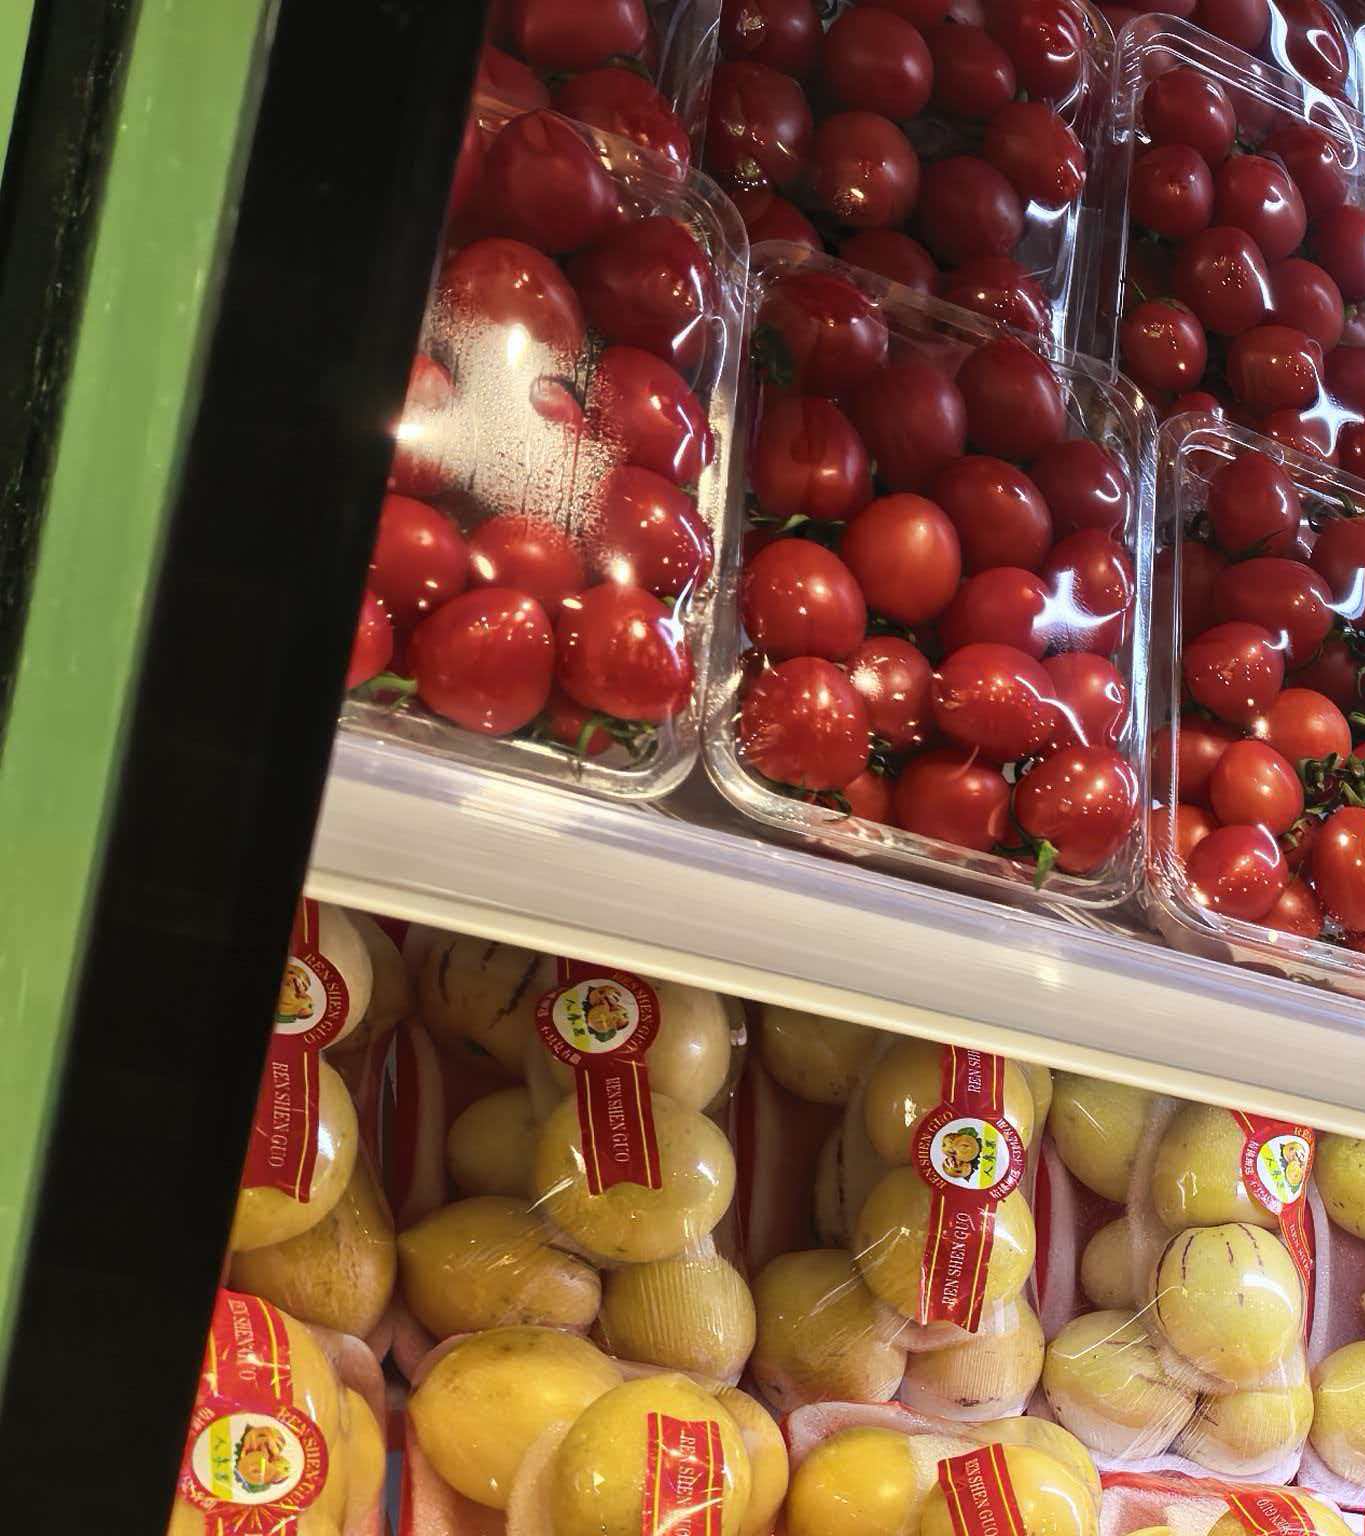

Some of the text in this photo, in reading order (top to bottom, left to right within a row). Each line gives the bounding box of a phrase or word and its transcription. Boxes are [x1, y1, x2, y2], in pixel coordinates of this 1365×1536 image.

[303, 953, 341, 1045] REN SHEN GUO
[268, 1061, 291, 1168] REN SHEN GUO
[968, 1068, 982, 1093] REN
[605, 1077, 630, 1163] REN SHEN GUO
[918, 1135, 932, 1167] SHEN
[928, 1111, 952, 1135] GUO
[942, 1212, 970, 1307] REN SHEN GUO
[304, 1436, 321, 1483] SHEN
[968, 1476, 990, 1508] SHEN
